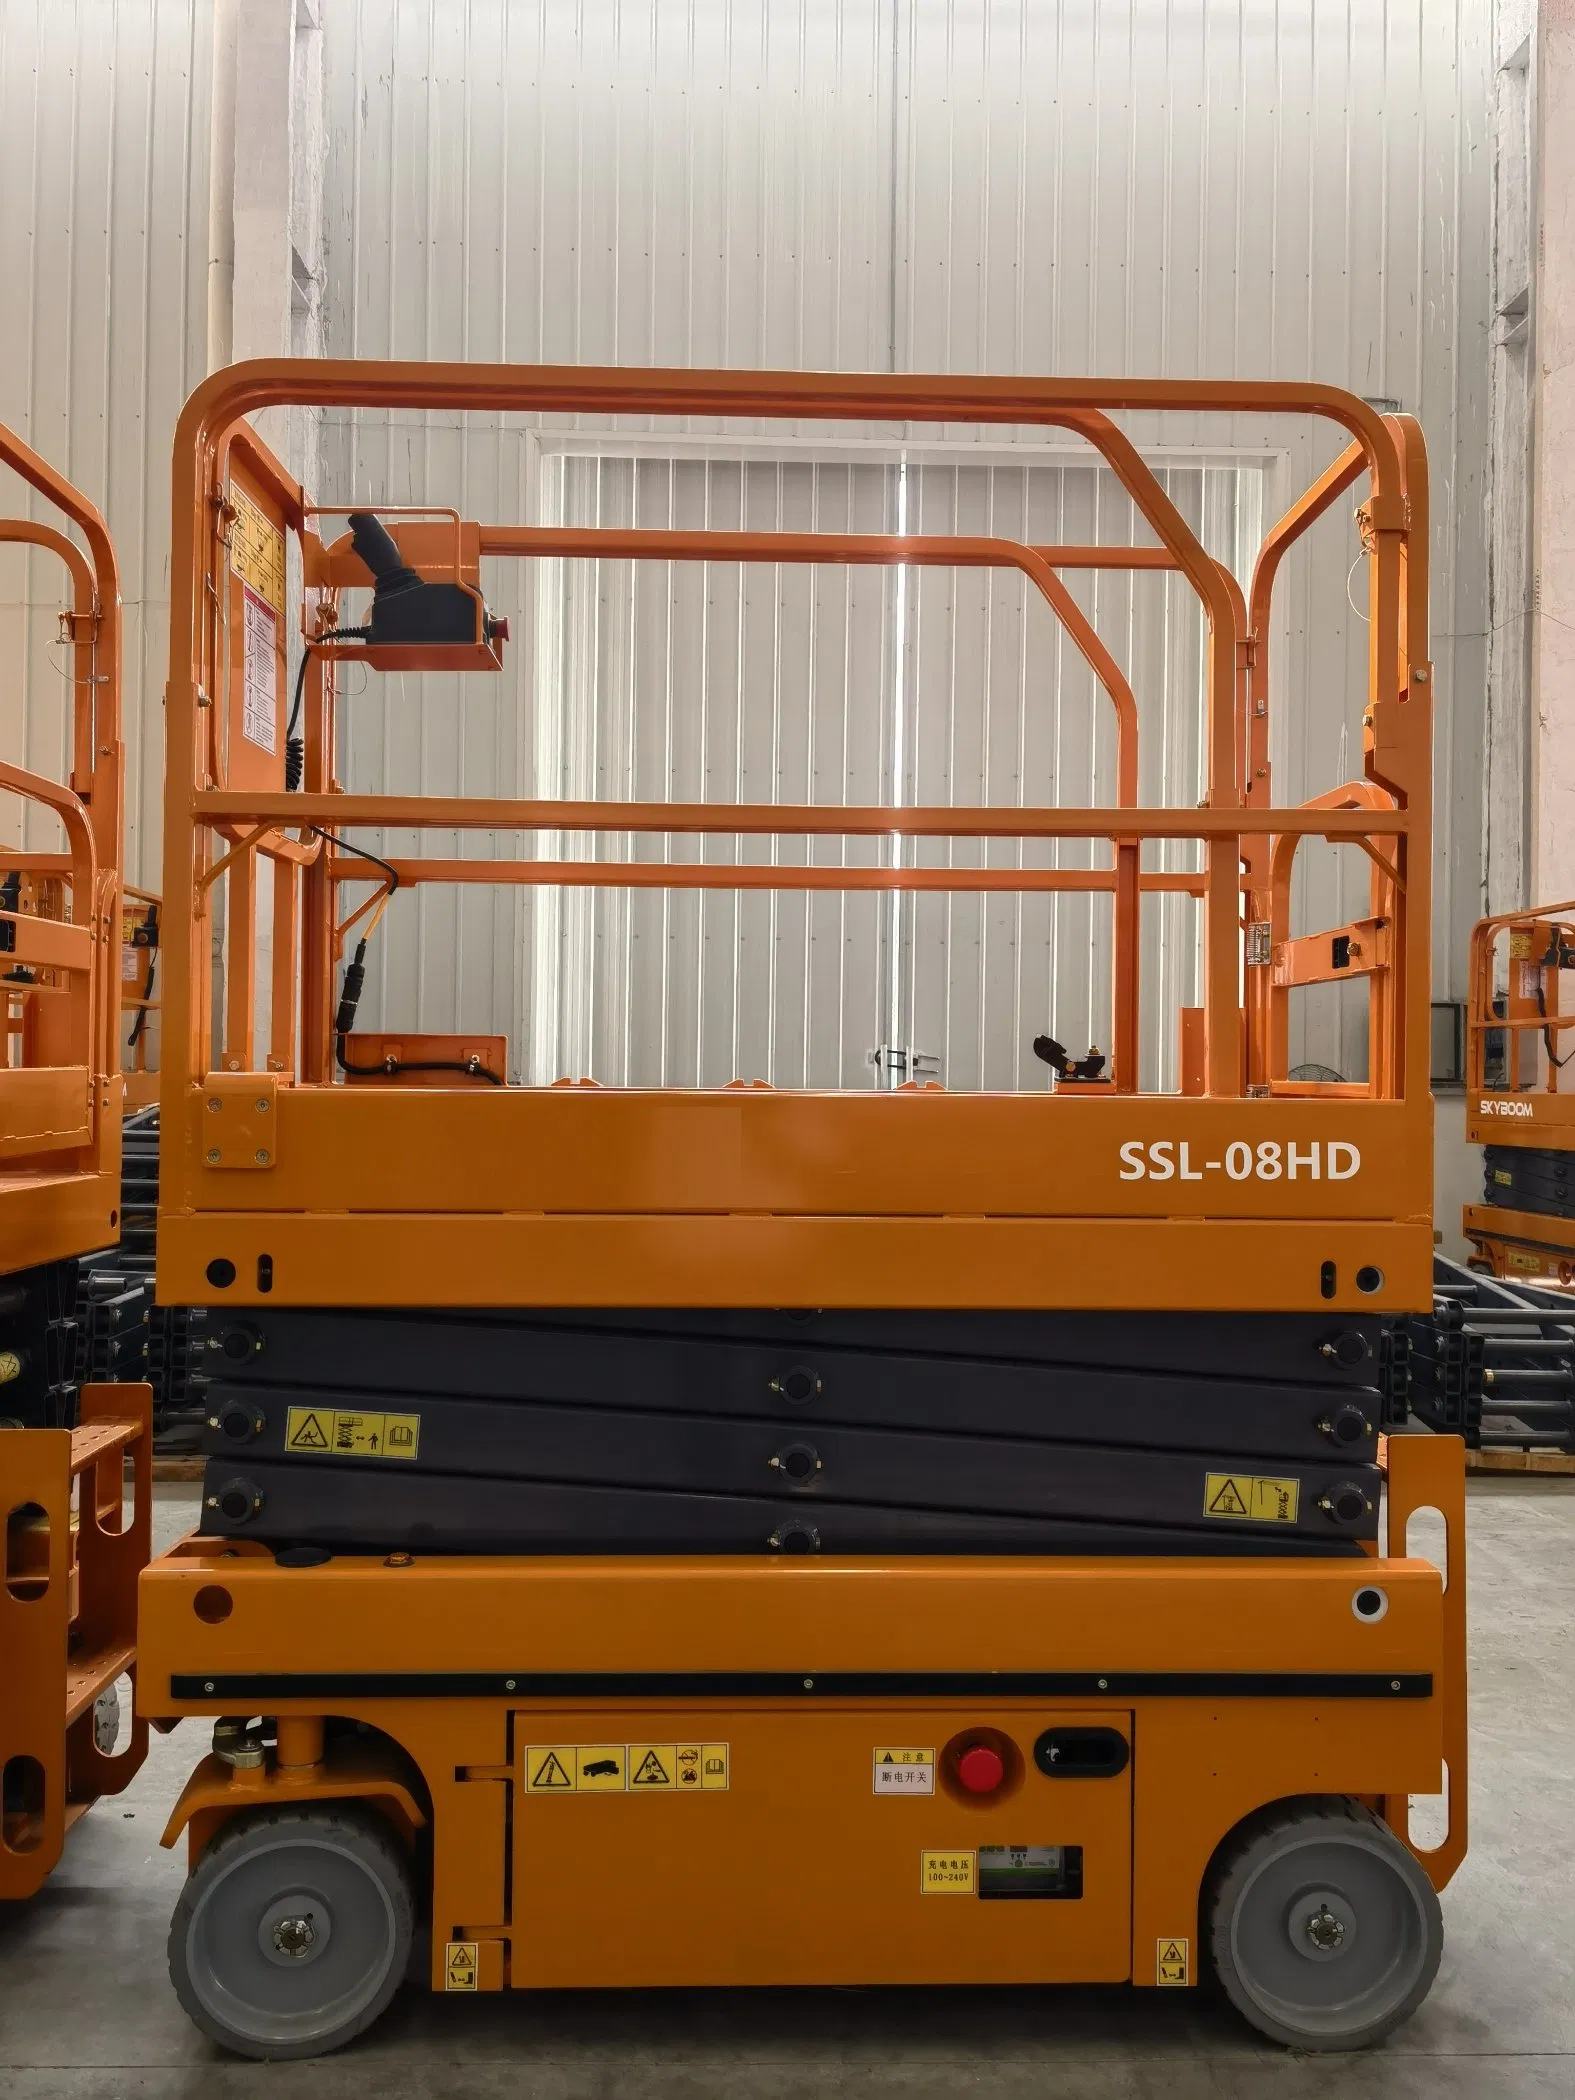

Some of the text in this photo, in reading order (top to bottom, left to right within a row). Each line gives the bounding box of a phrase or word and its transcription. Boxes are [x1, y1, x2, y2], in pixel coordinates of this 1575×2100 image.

[1480, 1100, 1533, 1117] SKYBOOM
[1119, 1141, 1361, 1180] SSL-08HD
[882, 1771, 927, 1783] 断电开关
[928, 1859, 969, 1870] 充电电压
